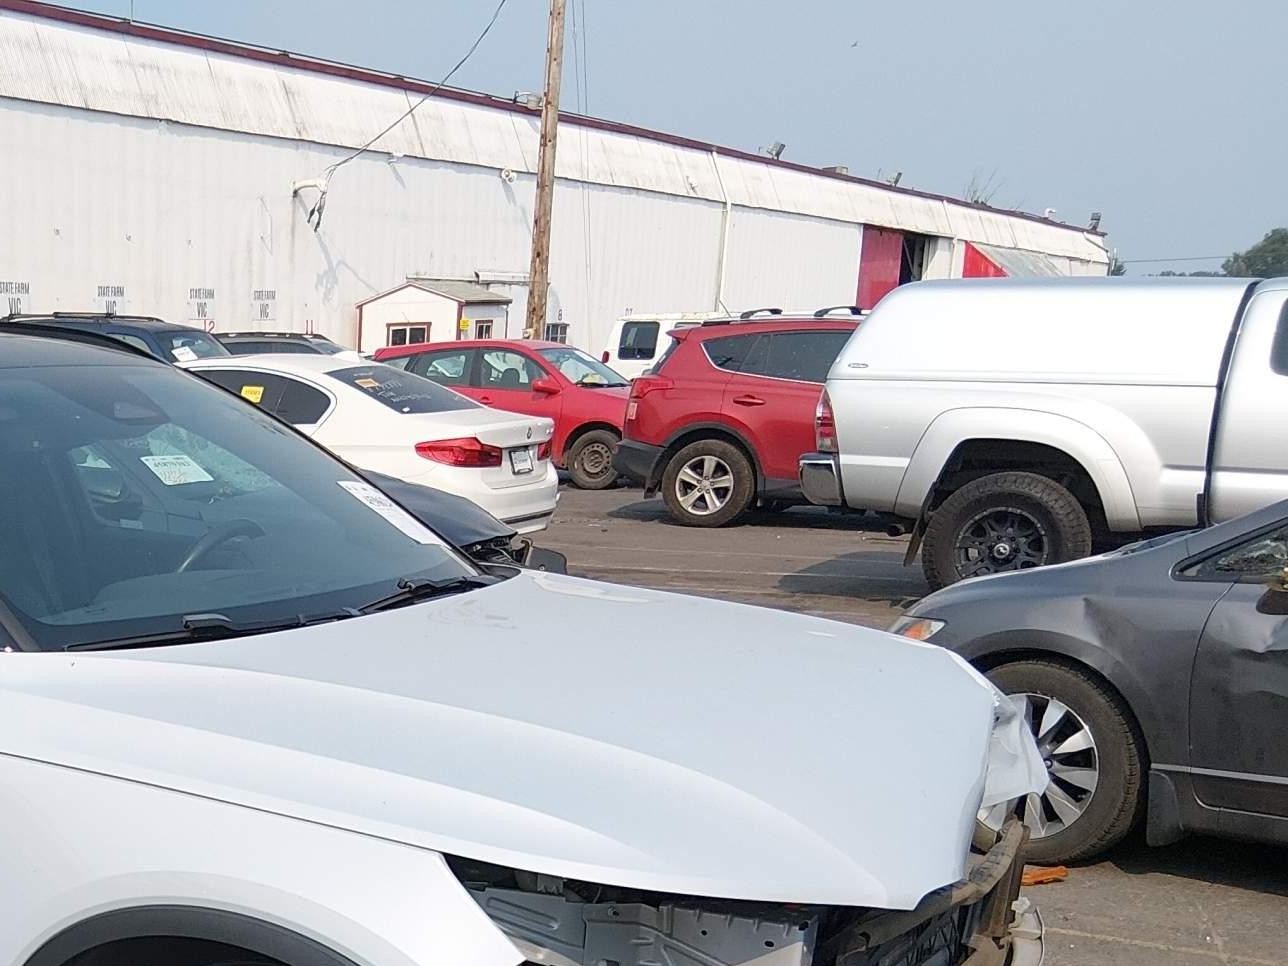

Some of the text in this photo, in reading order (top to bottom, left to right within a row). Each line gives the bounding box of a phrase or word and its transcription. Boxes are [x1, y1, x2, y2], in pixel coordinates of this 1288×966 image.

[0, 281, 30, 294] STATE FARM
[97, 286, 125, 297] STATE FARM
[8, 297, 22, 315] VIC
[196, 301, 208, 318] VIC
[259, 303, 270, 319] VIC
[203, 319, 215, 333] 12
